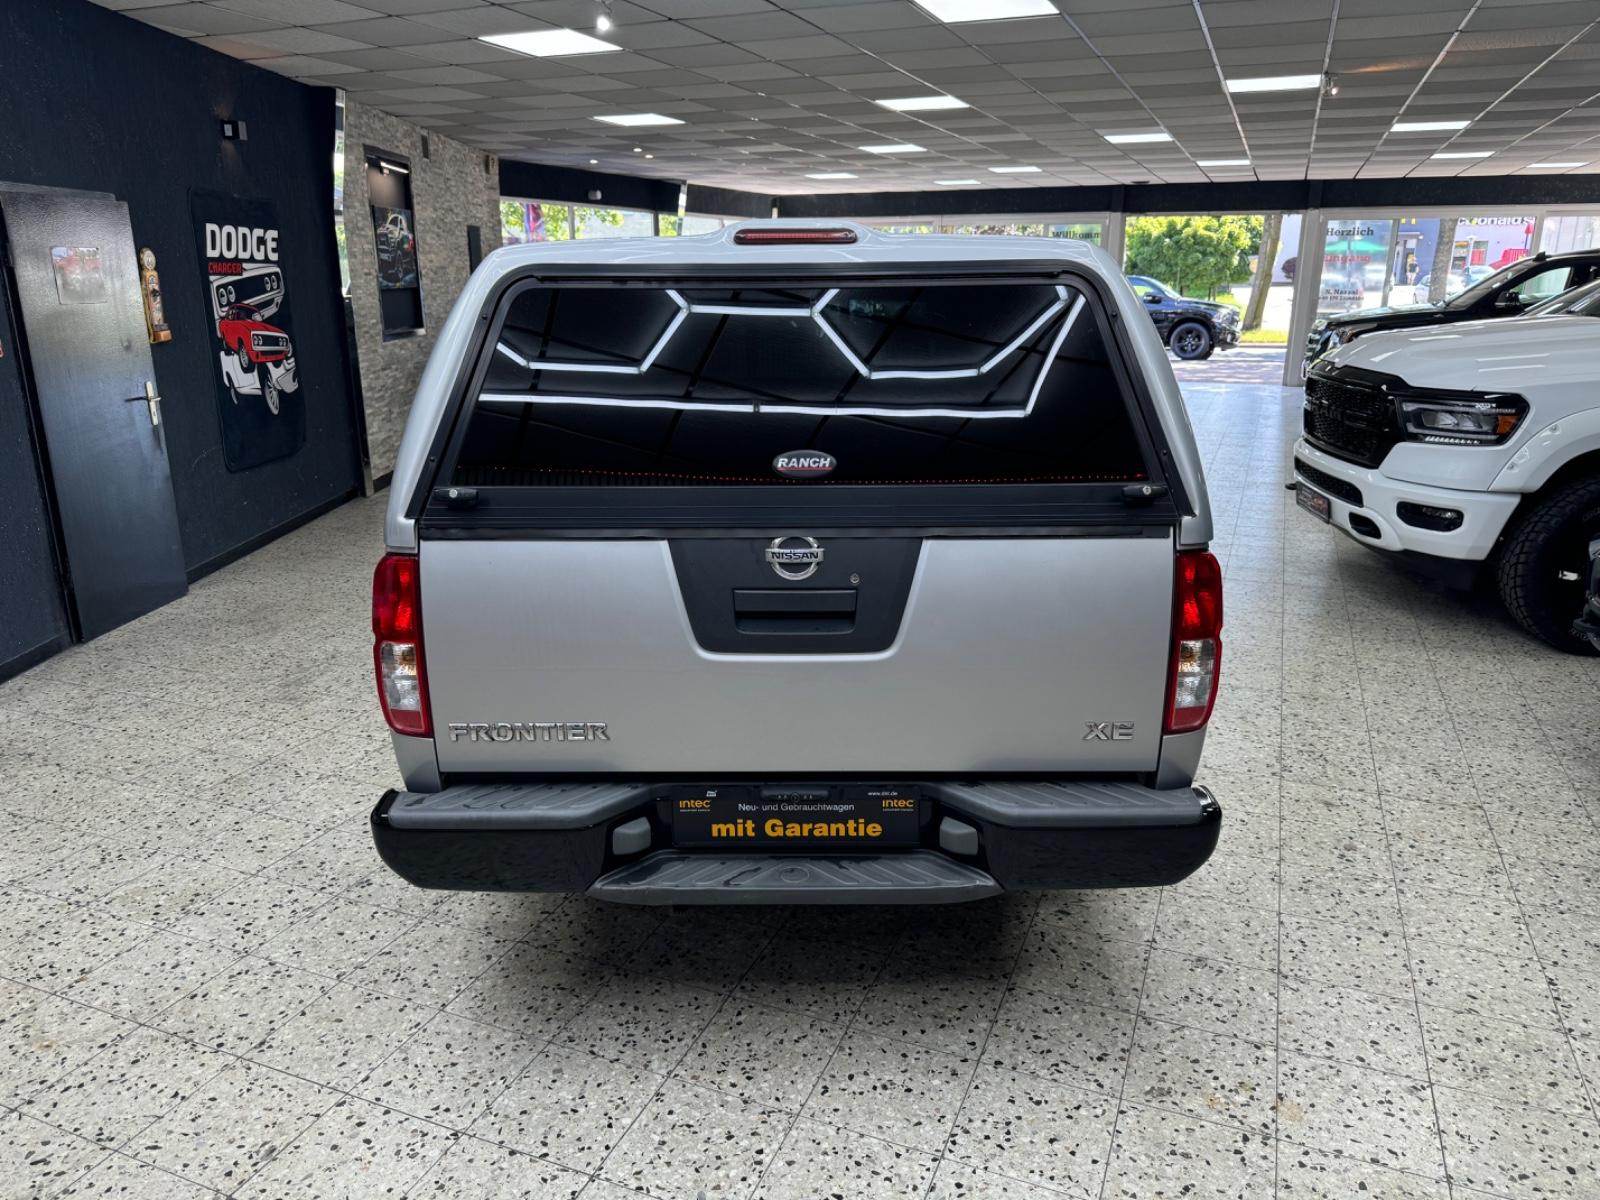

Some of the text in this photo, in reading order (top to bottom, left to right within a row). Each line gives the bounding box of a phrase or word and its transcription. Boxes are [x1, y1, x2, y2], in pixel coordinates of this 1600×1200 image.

[1326, 227, 1374, 236] Herzlich
[205, 222, 279, 261] DODGE
[208, 263, 242, 274] CHARGER
[777, 457, 832, 469] RANCH
[771, 551, 819, 561] NISSAN
[449, 722, 611, 742] FRONTIER
[1083, 721, 1134, 741] XE
[679, 799, 711, 808] intec
[738, 803, 854, 813] Neu- und Gebrauchtwagen
[882, 799, 914, 808] intec
[711, 818, 882, 838] mit Garantie
